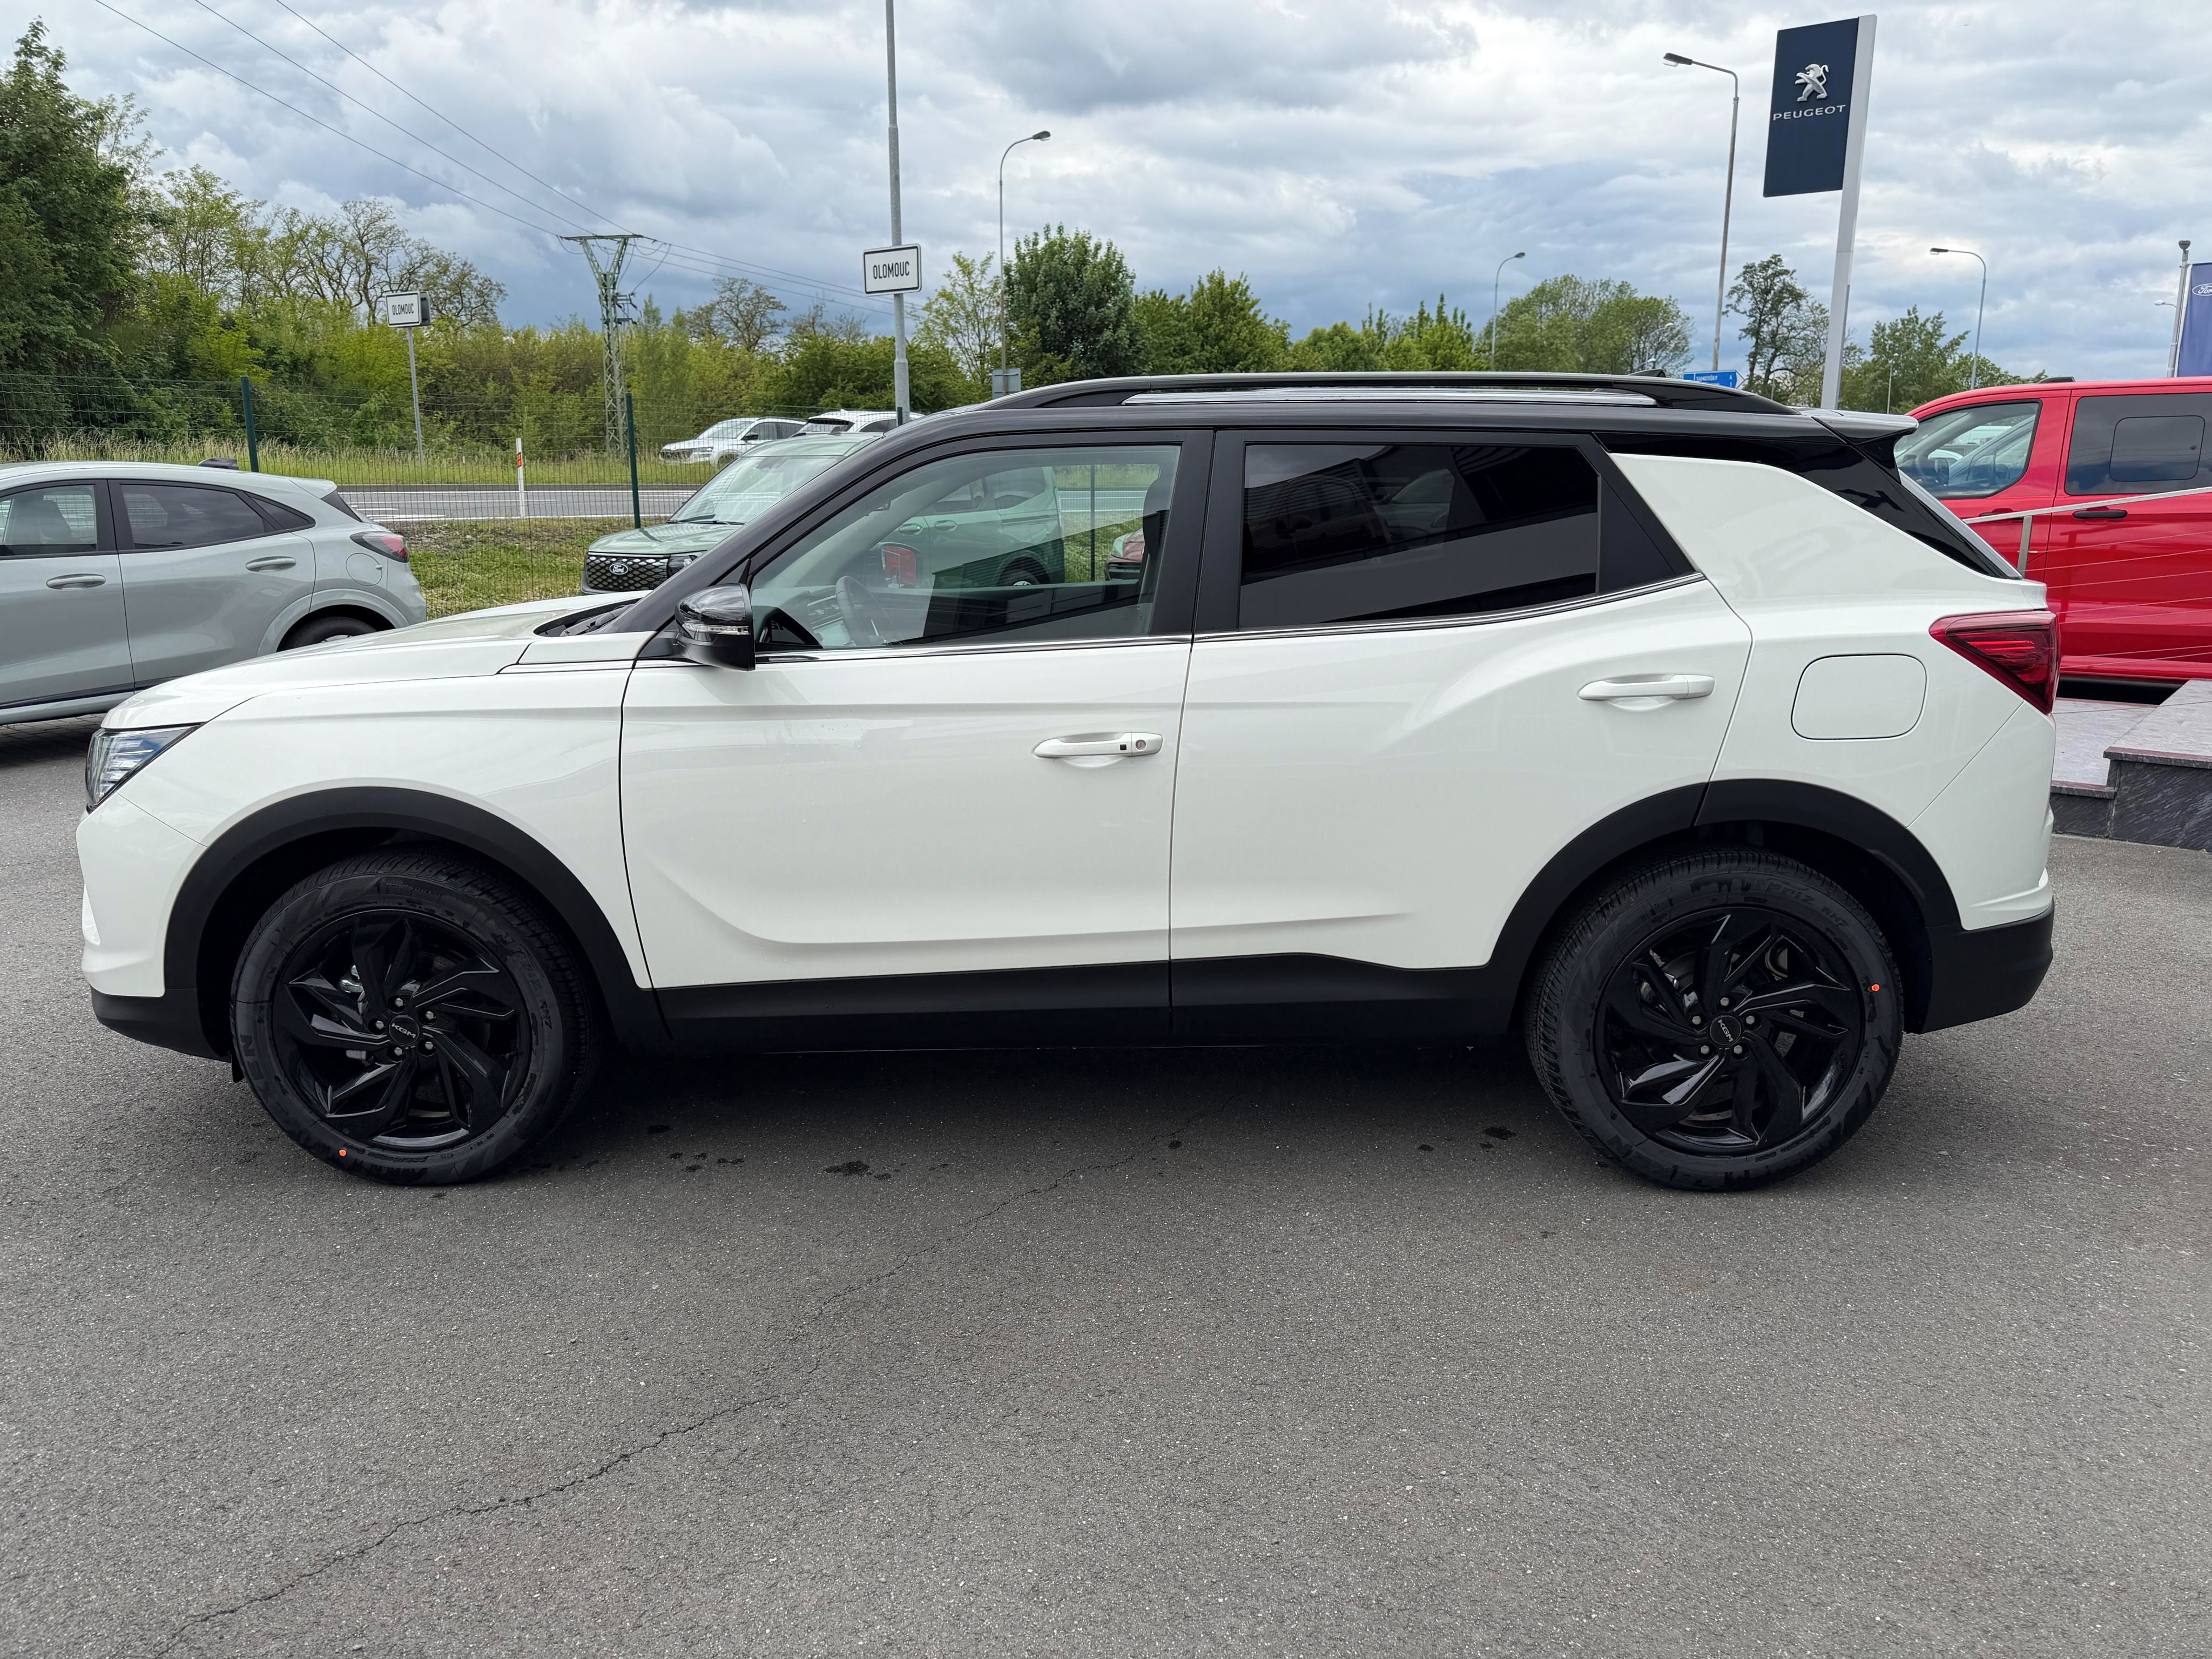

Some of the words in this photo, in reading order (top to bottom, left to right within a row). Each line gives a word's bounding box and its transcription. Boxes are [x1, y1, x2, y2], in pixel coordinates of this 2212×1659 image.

[1773, 105, 1846, 120] PEUGEOT
[873, 261, 909, 279] OLOMOUC
[2198, 285, 2212, 294] For
[392, 303, 414, 315] OLOMOUC
[392, 1023, 416, 1038] KGM
[1718, 1019, 1734, 1042] KGM
